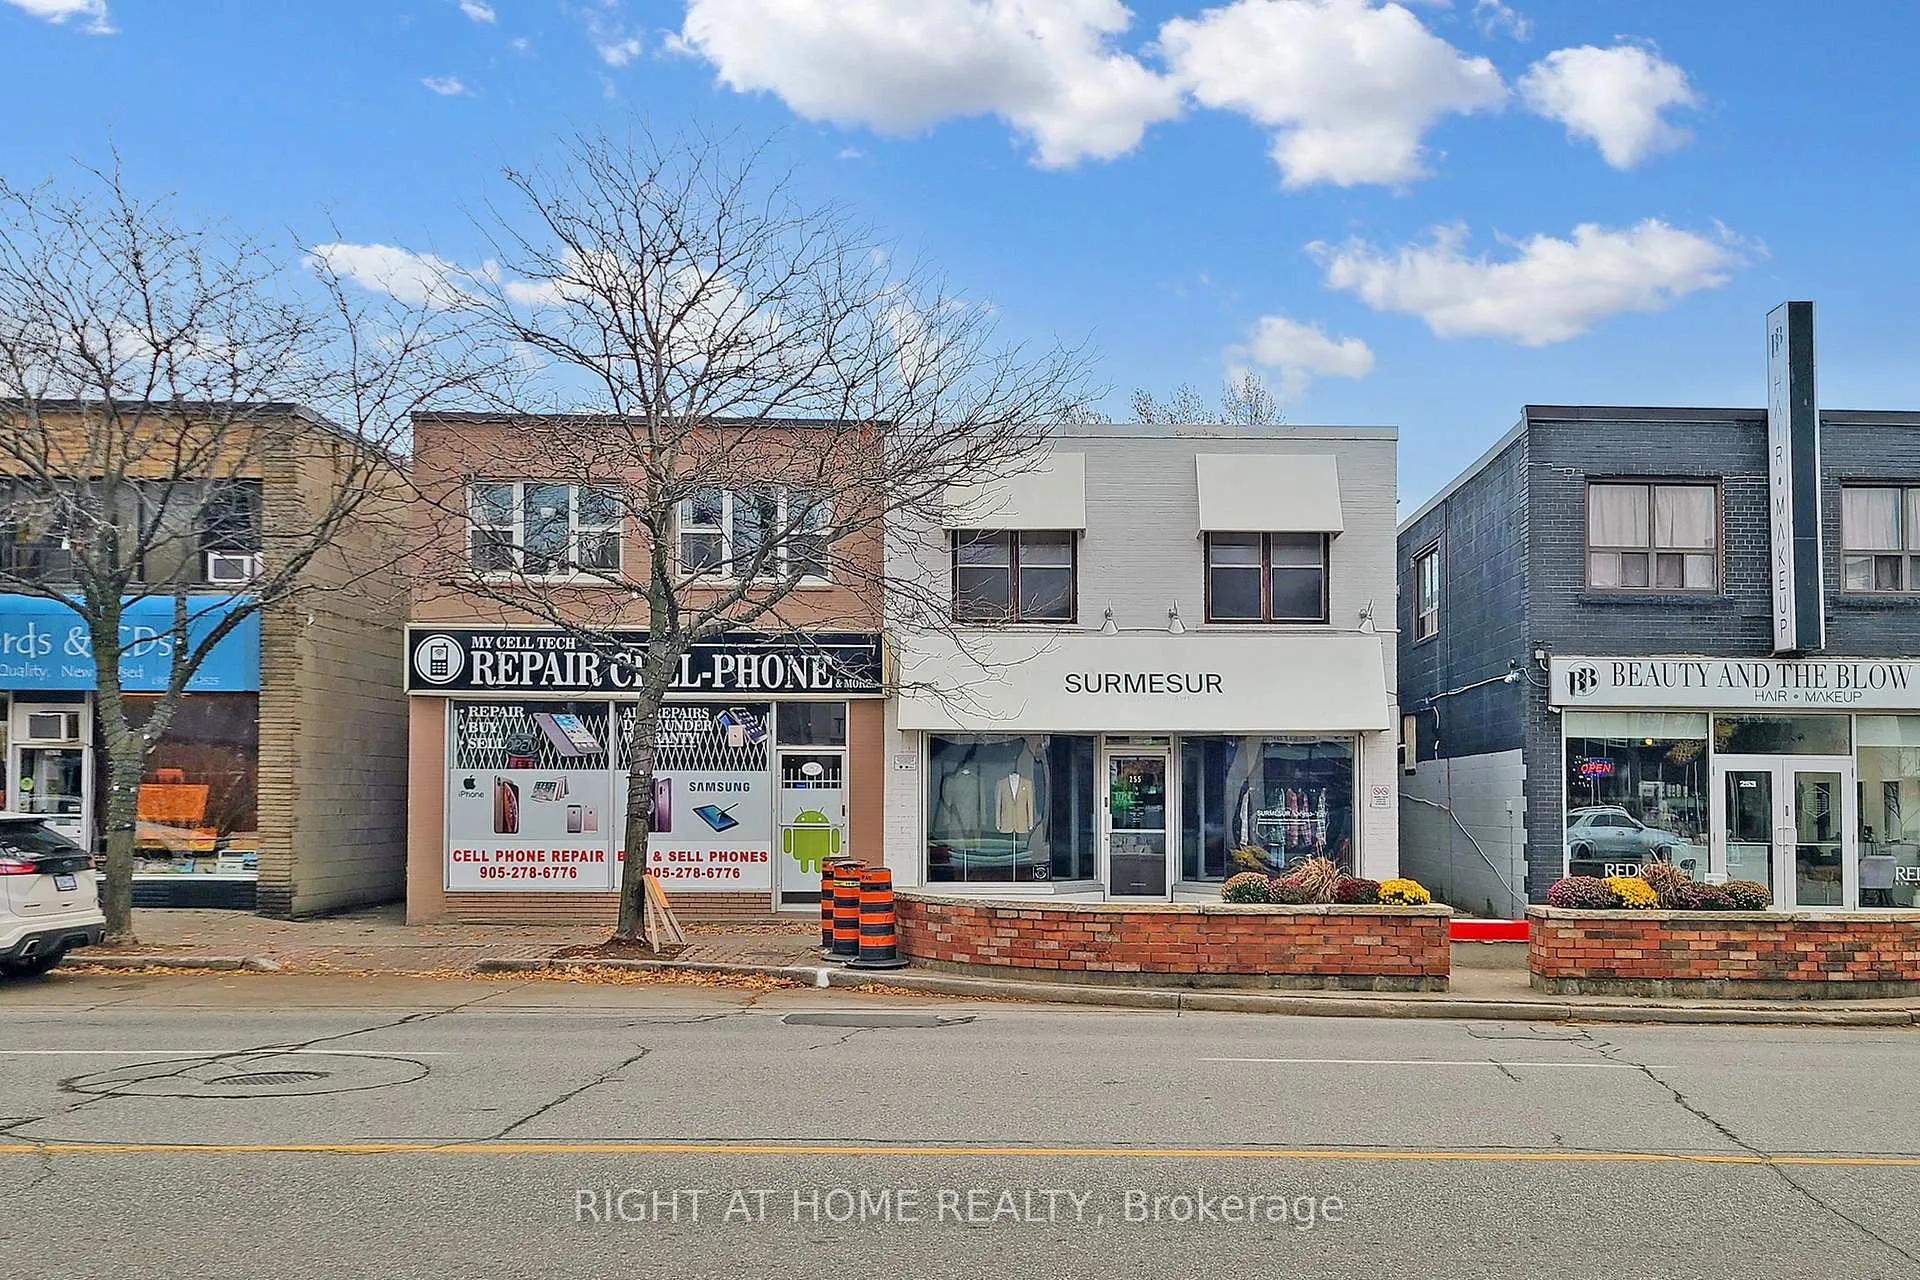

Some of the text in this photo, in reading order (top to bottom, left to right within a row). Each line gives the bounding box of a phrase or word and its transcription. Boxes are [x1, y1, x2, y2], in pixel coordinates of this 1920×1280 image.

[1775, 498, 1789, 640] MAKEUP
[0, 622, 52, 659] rds
[63, 626, 91, 657] &
[471, 636, 577, 650] MY CELL TECH
[470, 651, 833, 689] REPAIR CL-PHONE
[1611, 662, 1912, 690] BEAUTY AND THE BLOW
[1064, 673, 1224, 694] SURMESUR
[1754, 690, 1863, 703] HAIR MAKEUP
[468, 706, 525, 718] REPAIR
[468, 722, 499, 734] BUY
[664, 720, 713, 732] UNDER
[467, 738, 508, 750] SELL
[1581, 763, 1612, 774] OPEN
[1129, 775, 1142, 783] 255
[1739, 780, 1757, 788] 253
[689, 782, 750, 792] SAMSUNG
[458, 790, 485, 799] iPhone
[453, 850, 489, 862] CELL
[496, 850, 545, 862] PHONE
[552, 850, 604, 862] REPAIR
[653, 851, 768, 863] & SELL PHONES
[480, 866, 577, 879] 905-278-6776
[644, 867, 741, 879] 905-278-6776
[1604, 863, 1648, 878] REDK
[1895, 866, 1920, 881] RE
